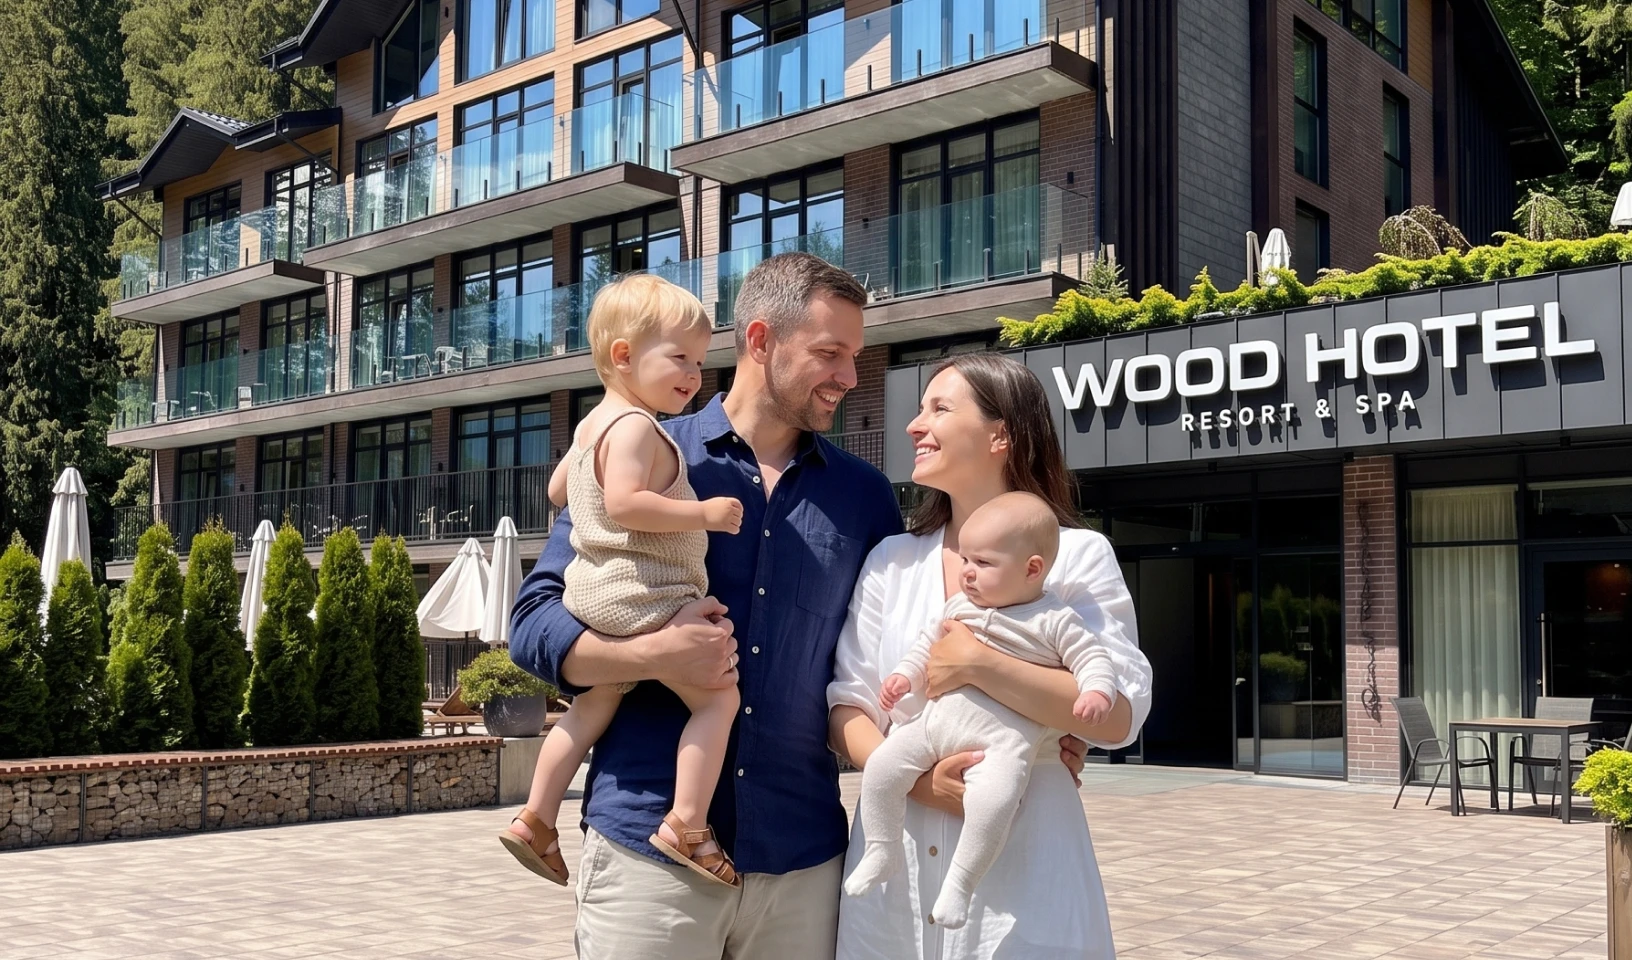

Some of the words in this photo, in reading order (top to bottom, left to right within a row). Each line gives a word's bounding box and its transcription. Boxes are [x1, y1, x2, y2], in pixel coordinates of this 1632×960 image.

[1051, 339, 1280, 410] WOOD
[1304, 301, 1597, 383] HOTEL
[1181, 402, 1295, 432] RESORT
[1314, 398, 1332, 419] &
[1355, 390, 1416, 415] SPA
